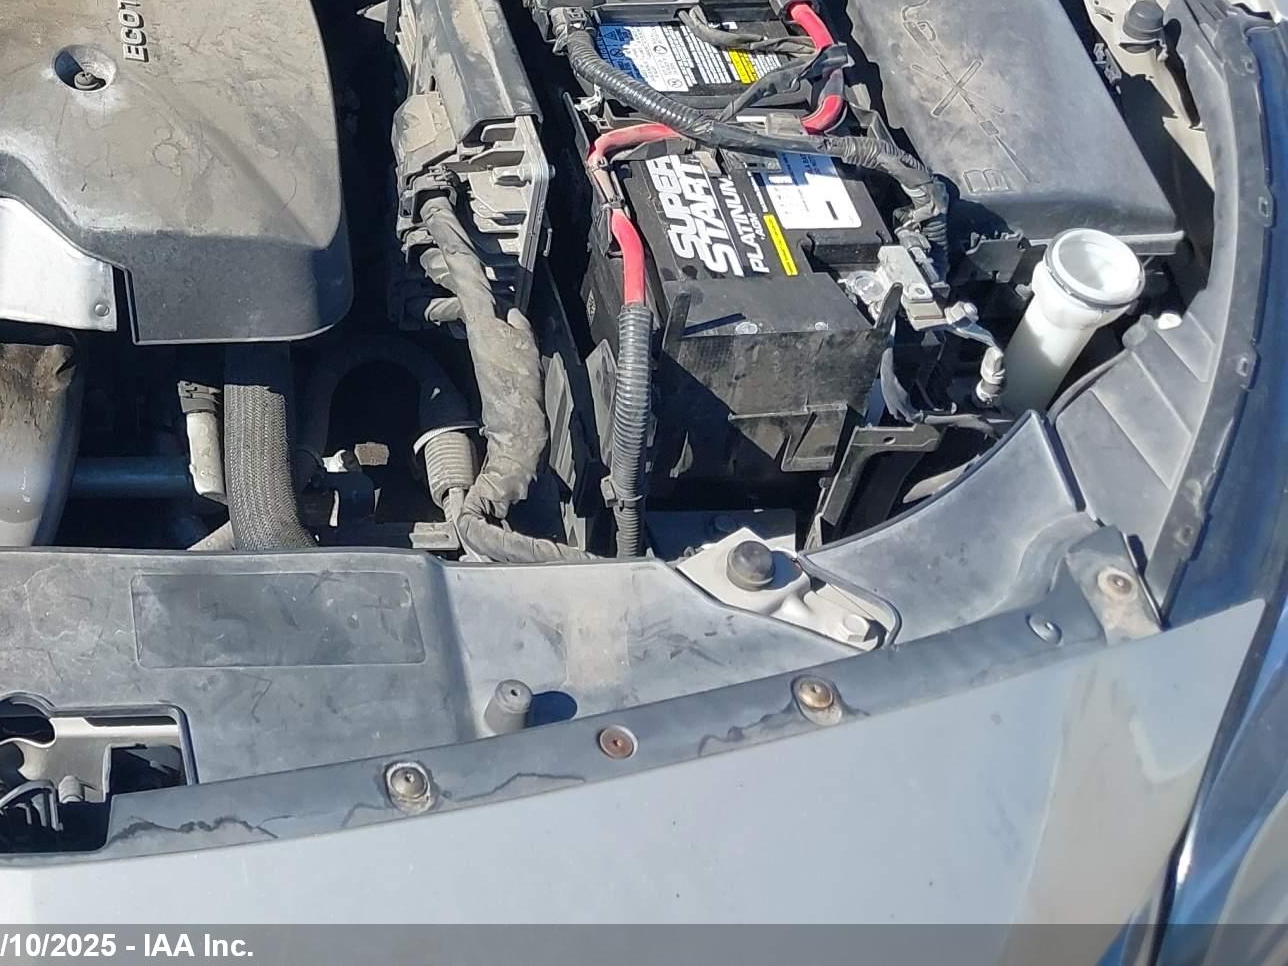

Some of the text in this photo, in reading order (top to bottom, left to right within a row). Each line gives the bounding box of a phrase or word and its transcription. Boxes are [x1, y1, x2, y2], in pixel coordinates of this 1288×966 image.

[645, 155, 697, 259] SUPER
[669, 155, 745, 278] START
[718, 175, 770, 273] PLATINUM
